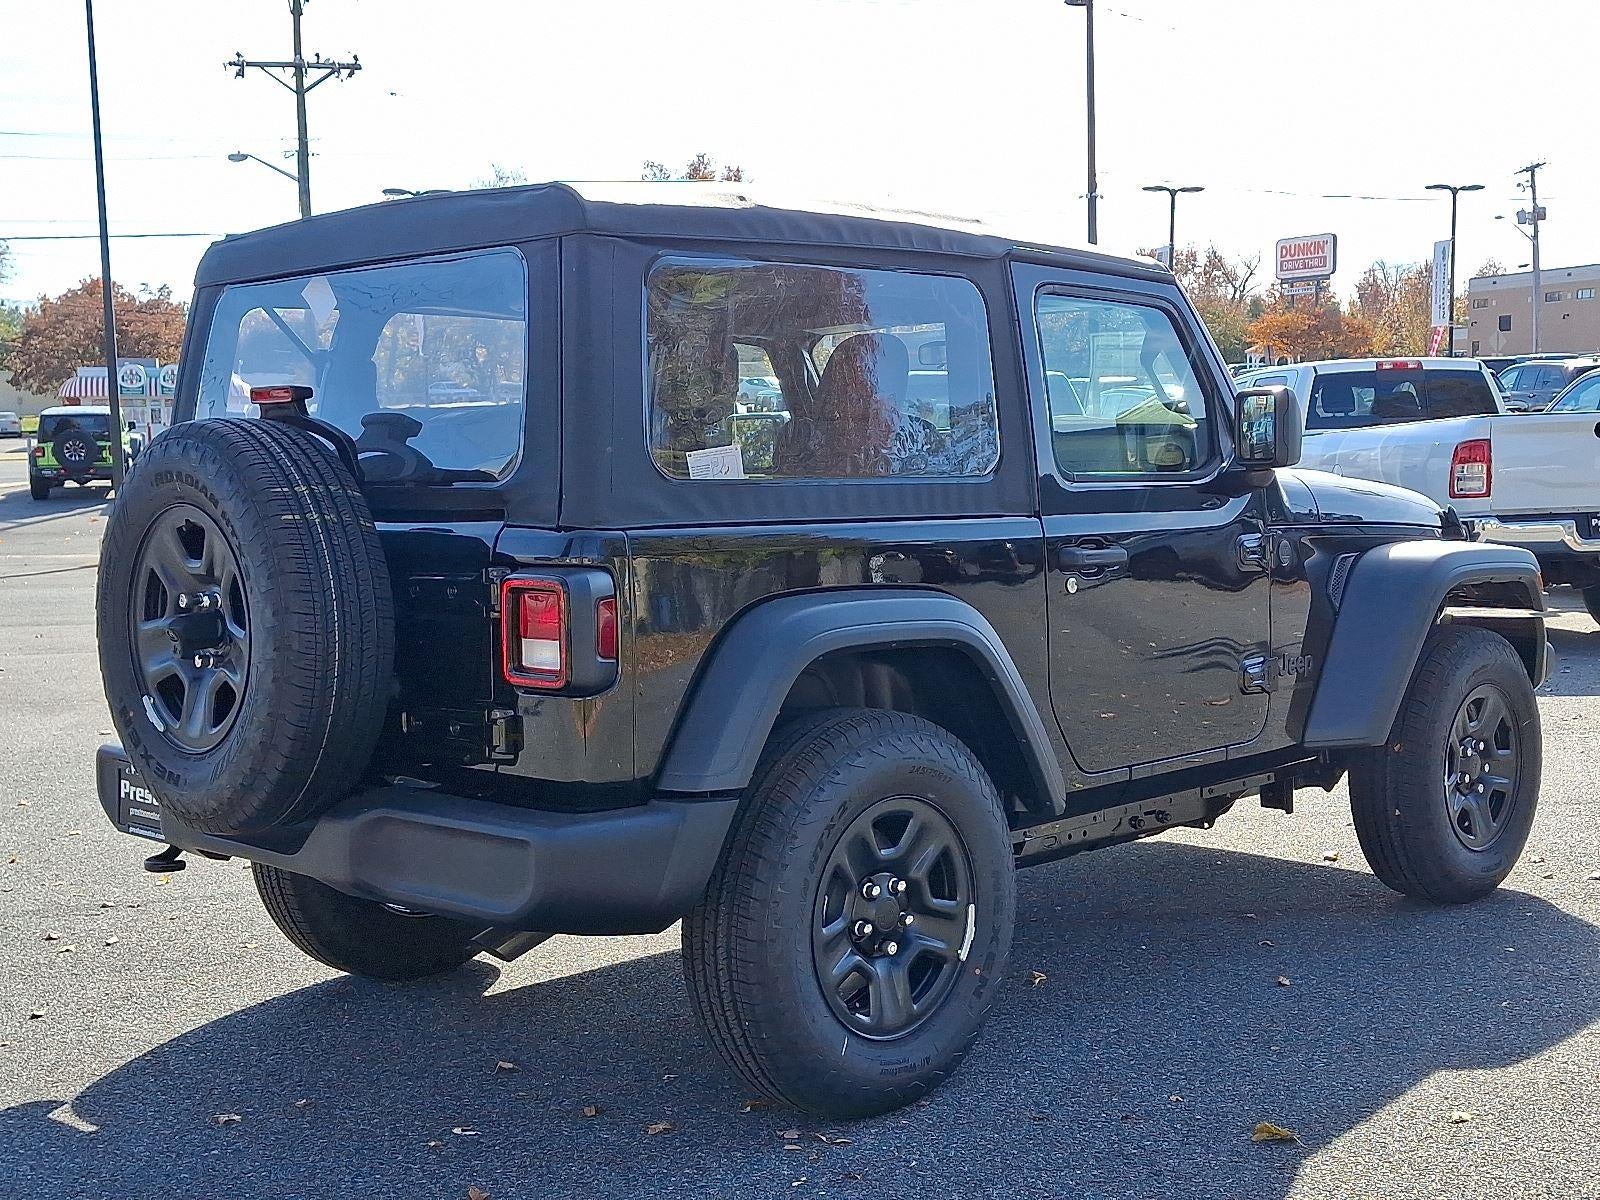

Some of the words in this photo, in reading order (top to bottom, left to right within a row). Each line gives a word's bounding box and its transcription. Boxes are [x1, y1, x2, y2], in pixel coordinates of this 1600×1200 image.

[1280, 240, 1328, 258] DUNKIN'
[1283, 260, 1303, 269] DRIVE
[1305, 258, 1323, 268] THRU
[1278, 652, 1312, 677] Jeep
